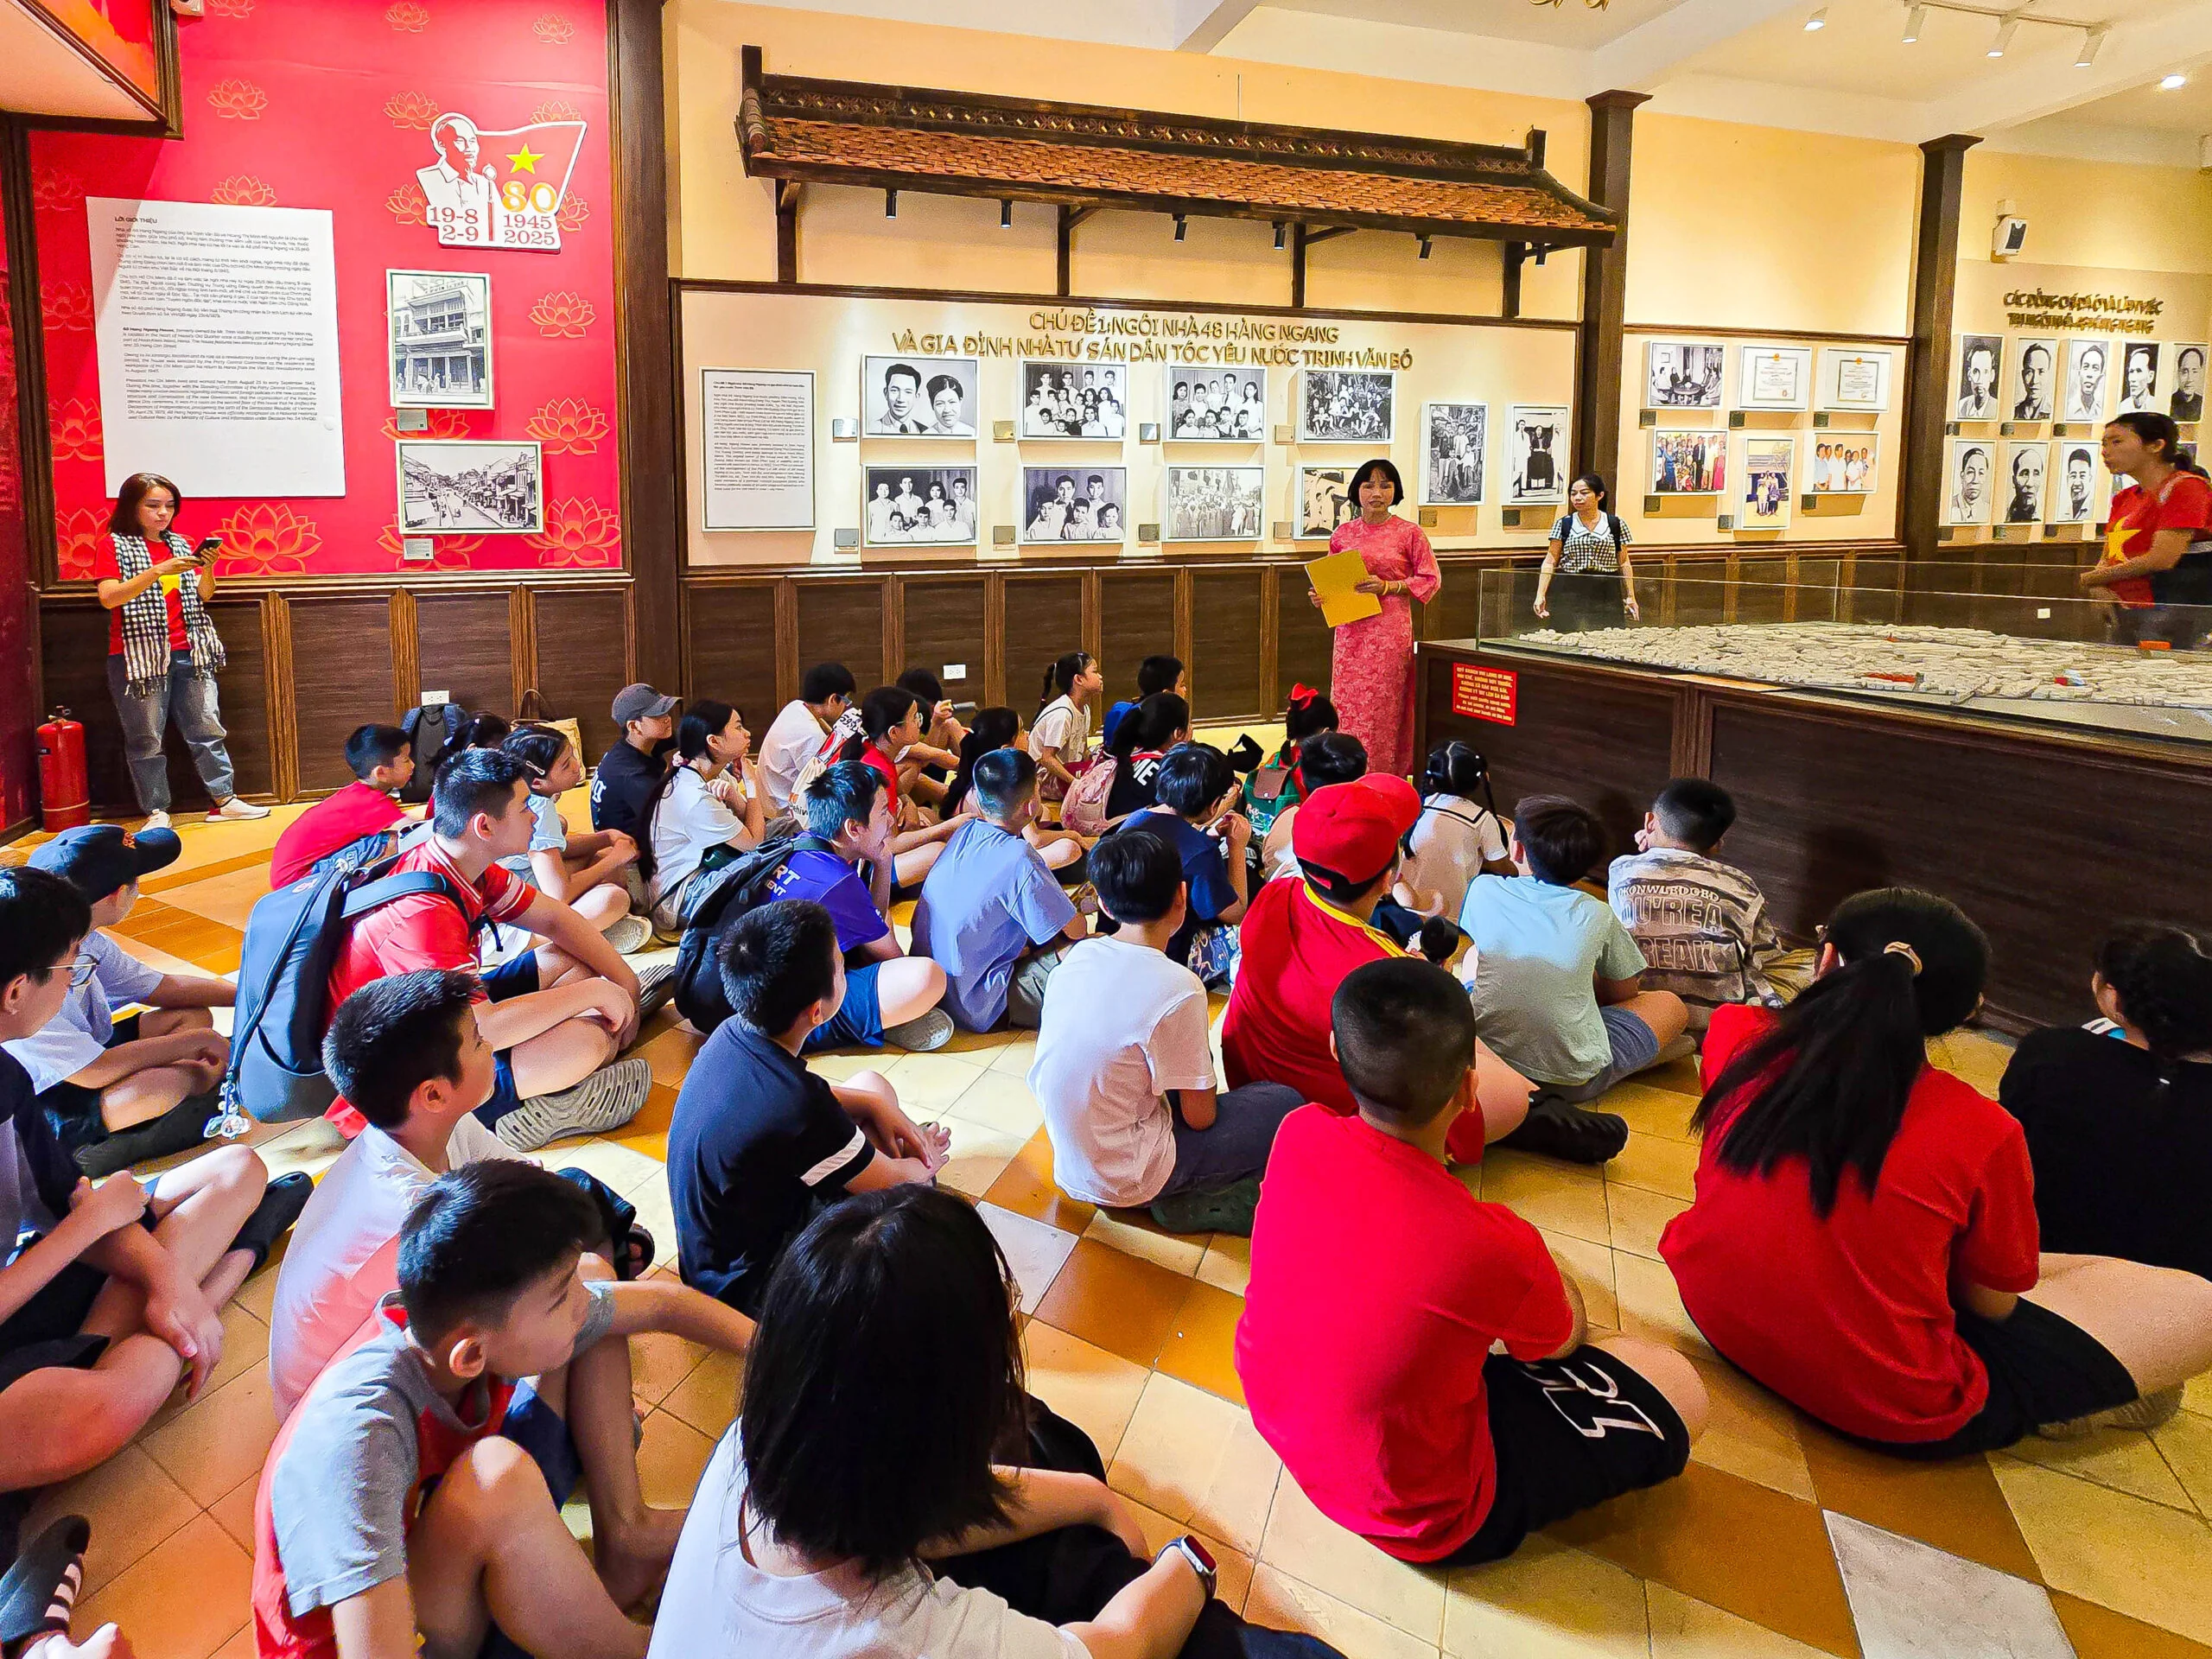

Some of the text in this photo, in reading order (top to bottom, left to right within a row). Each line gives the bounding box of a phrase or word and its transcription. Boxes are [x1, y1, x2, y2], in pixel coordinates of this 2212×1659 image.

[501, 181, 557, 213] 80
[430, 207, 479, 225] 19-8
[503, 213, 552, 229] 1945
[442, 225, 479, 242] 2-9
[505, 230, 555, 245] 2025
[1029, 308, 1068, 332] CHỦ
[1071, 307, 1096, 334] ĐỀ
[1162, 315, 1199, 340] NHÀ
[1201, 321, 1223, 340] 48
[1225, 317, 1276, 341] HÀNG
[1279, 324, 1340, 345] NGANG
[892, 328, 918, 355] VÀ
[920, 334, 958, 355] GIA
